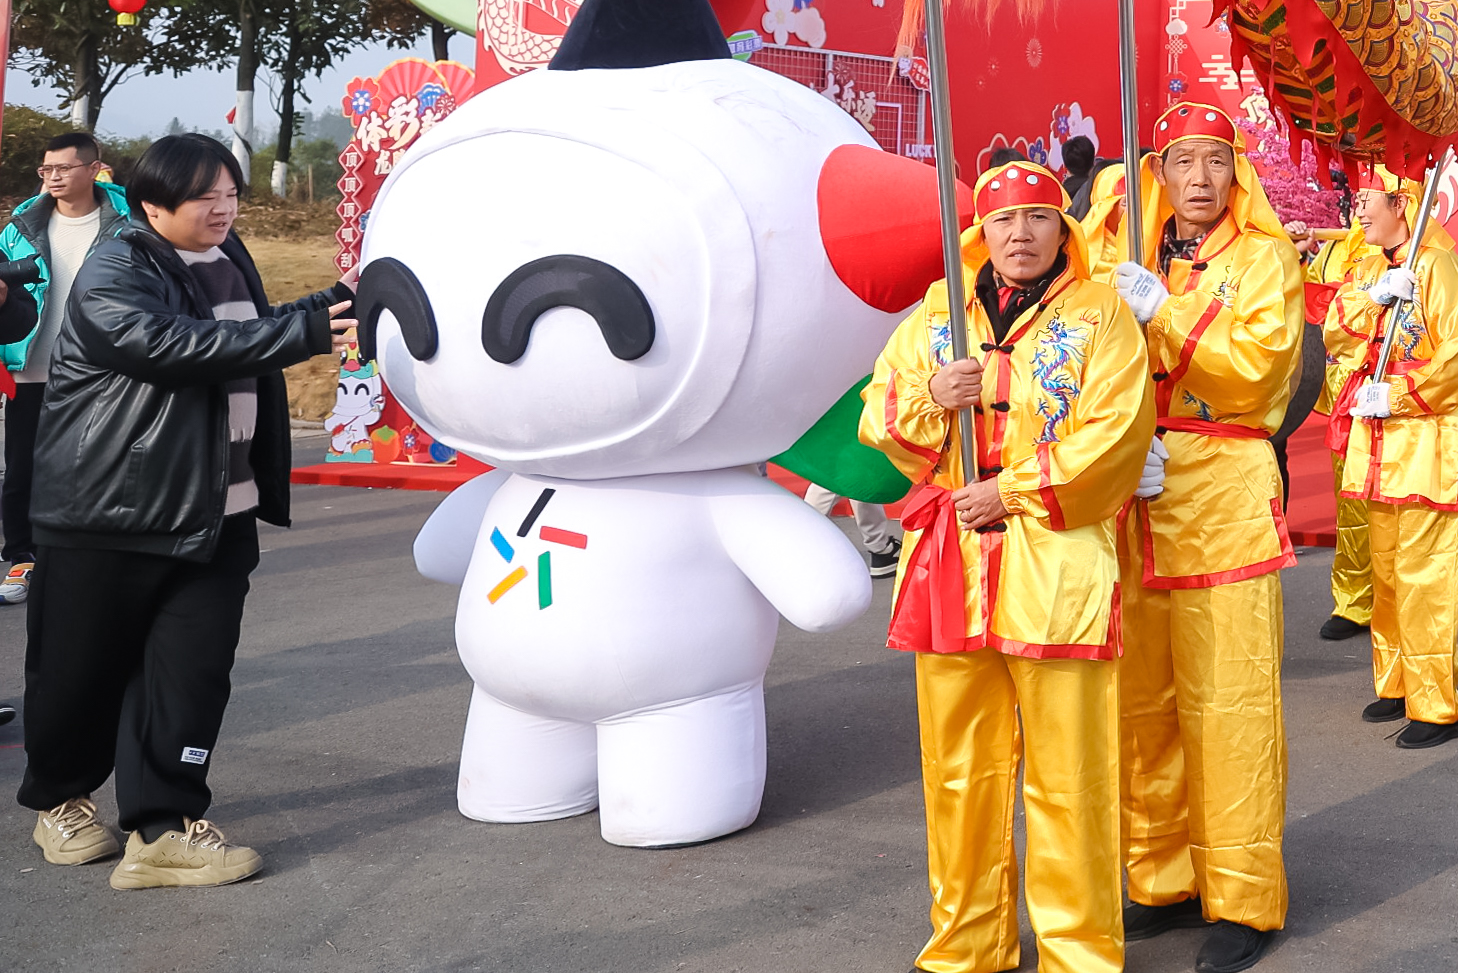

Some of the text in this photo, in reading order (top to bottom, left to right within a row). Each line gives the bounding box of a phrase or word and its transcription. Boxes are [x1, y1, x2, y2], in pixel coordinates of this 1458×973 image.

[809, 71, 877, 132] 大乐透
[905, 143, 935, 158] LUCK
